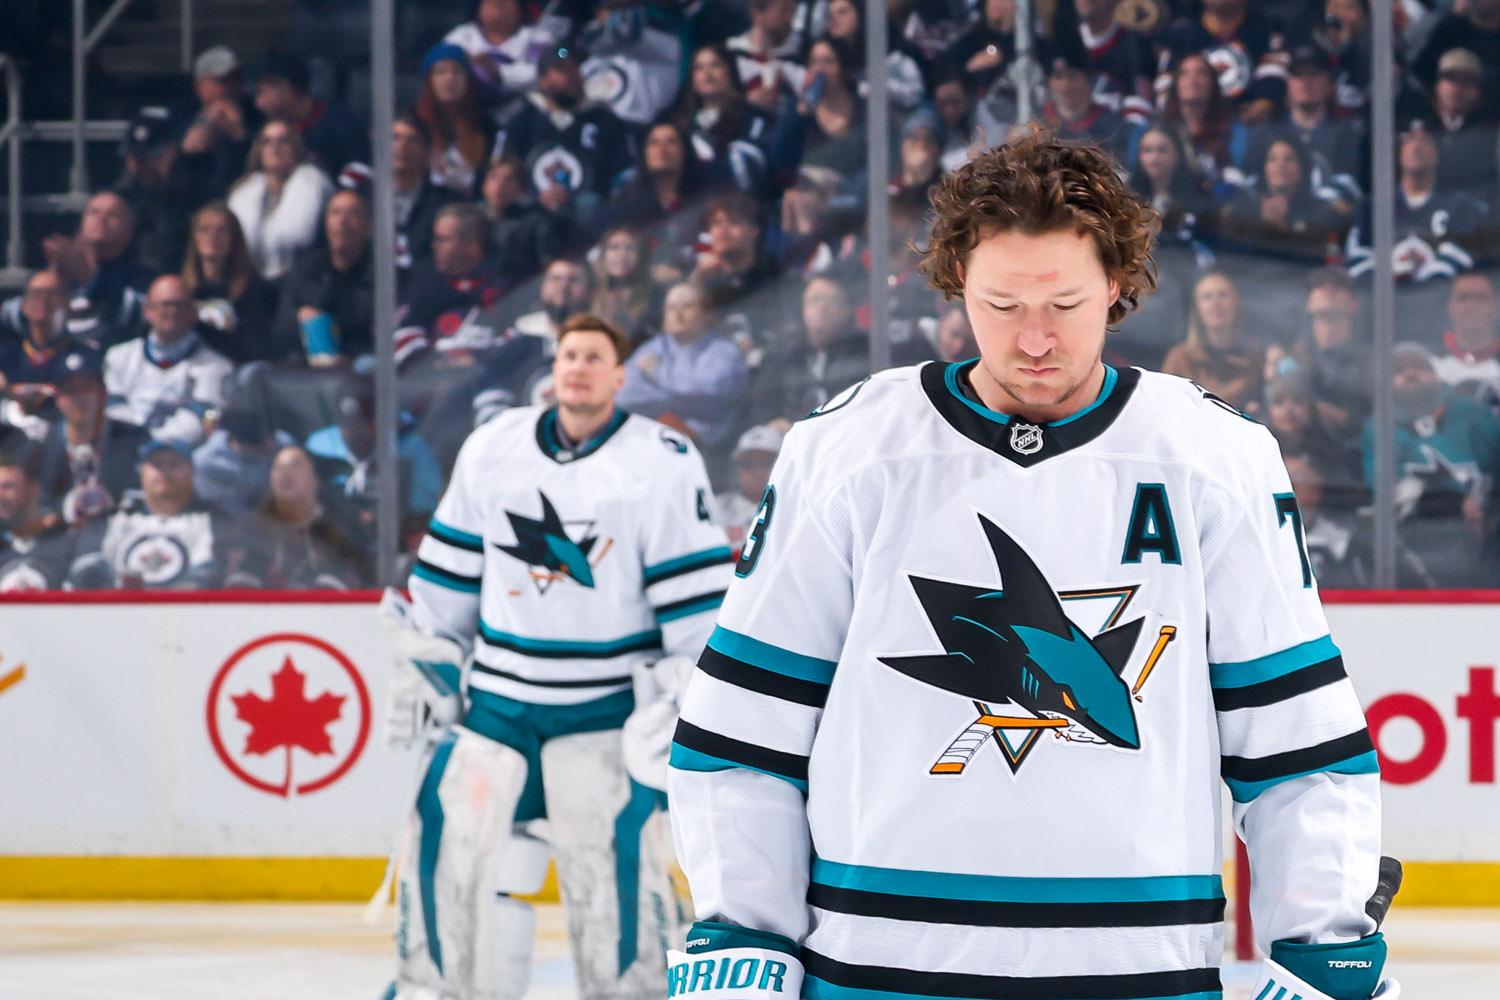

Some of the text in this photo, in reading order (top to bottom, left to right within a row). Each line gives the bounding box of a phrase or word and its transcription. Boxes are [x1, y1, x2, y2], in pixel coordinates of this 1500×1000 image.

[1431, 209, 1450, 237] C
[1121, 482, 1183, 566] A
[1328, 960, 1373, 969] TOFFOLI
